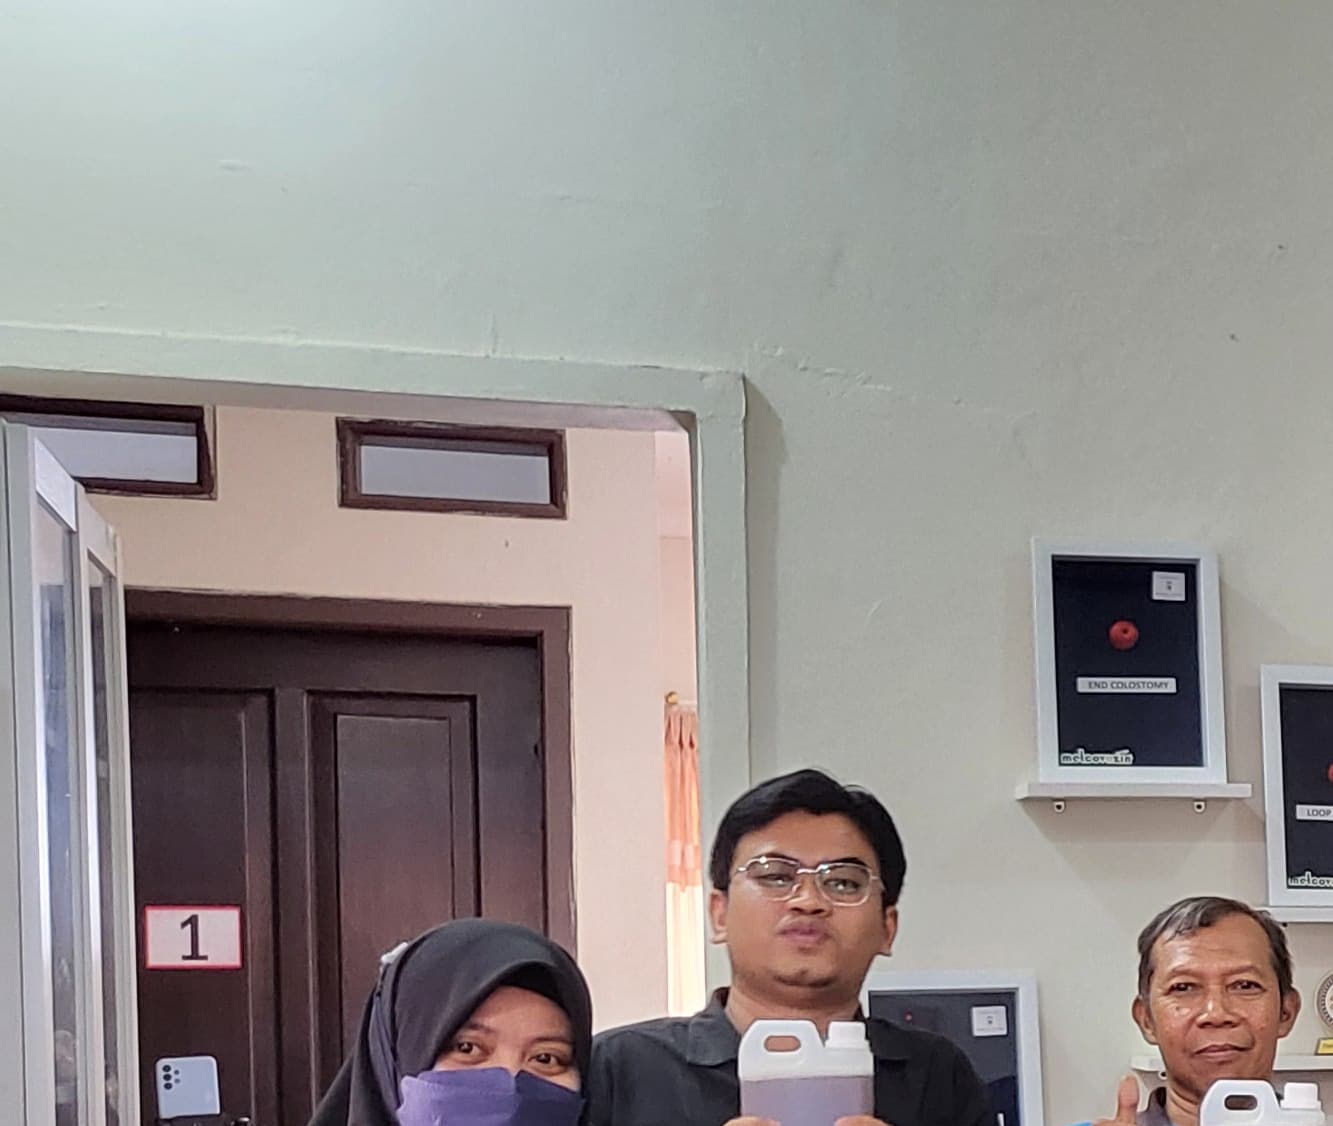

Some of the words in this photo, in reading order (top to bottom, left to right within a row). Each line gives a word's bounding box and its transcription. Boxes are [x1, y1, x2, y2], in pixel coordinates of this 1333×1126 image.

[1088, 681, 1108, 689] END
[1110, 681, 1169, 689] COLOSTOMY
[1307, 808, 1332, 817] LOOP
[180, 914, 208, 961] 1
